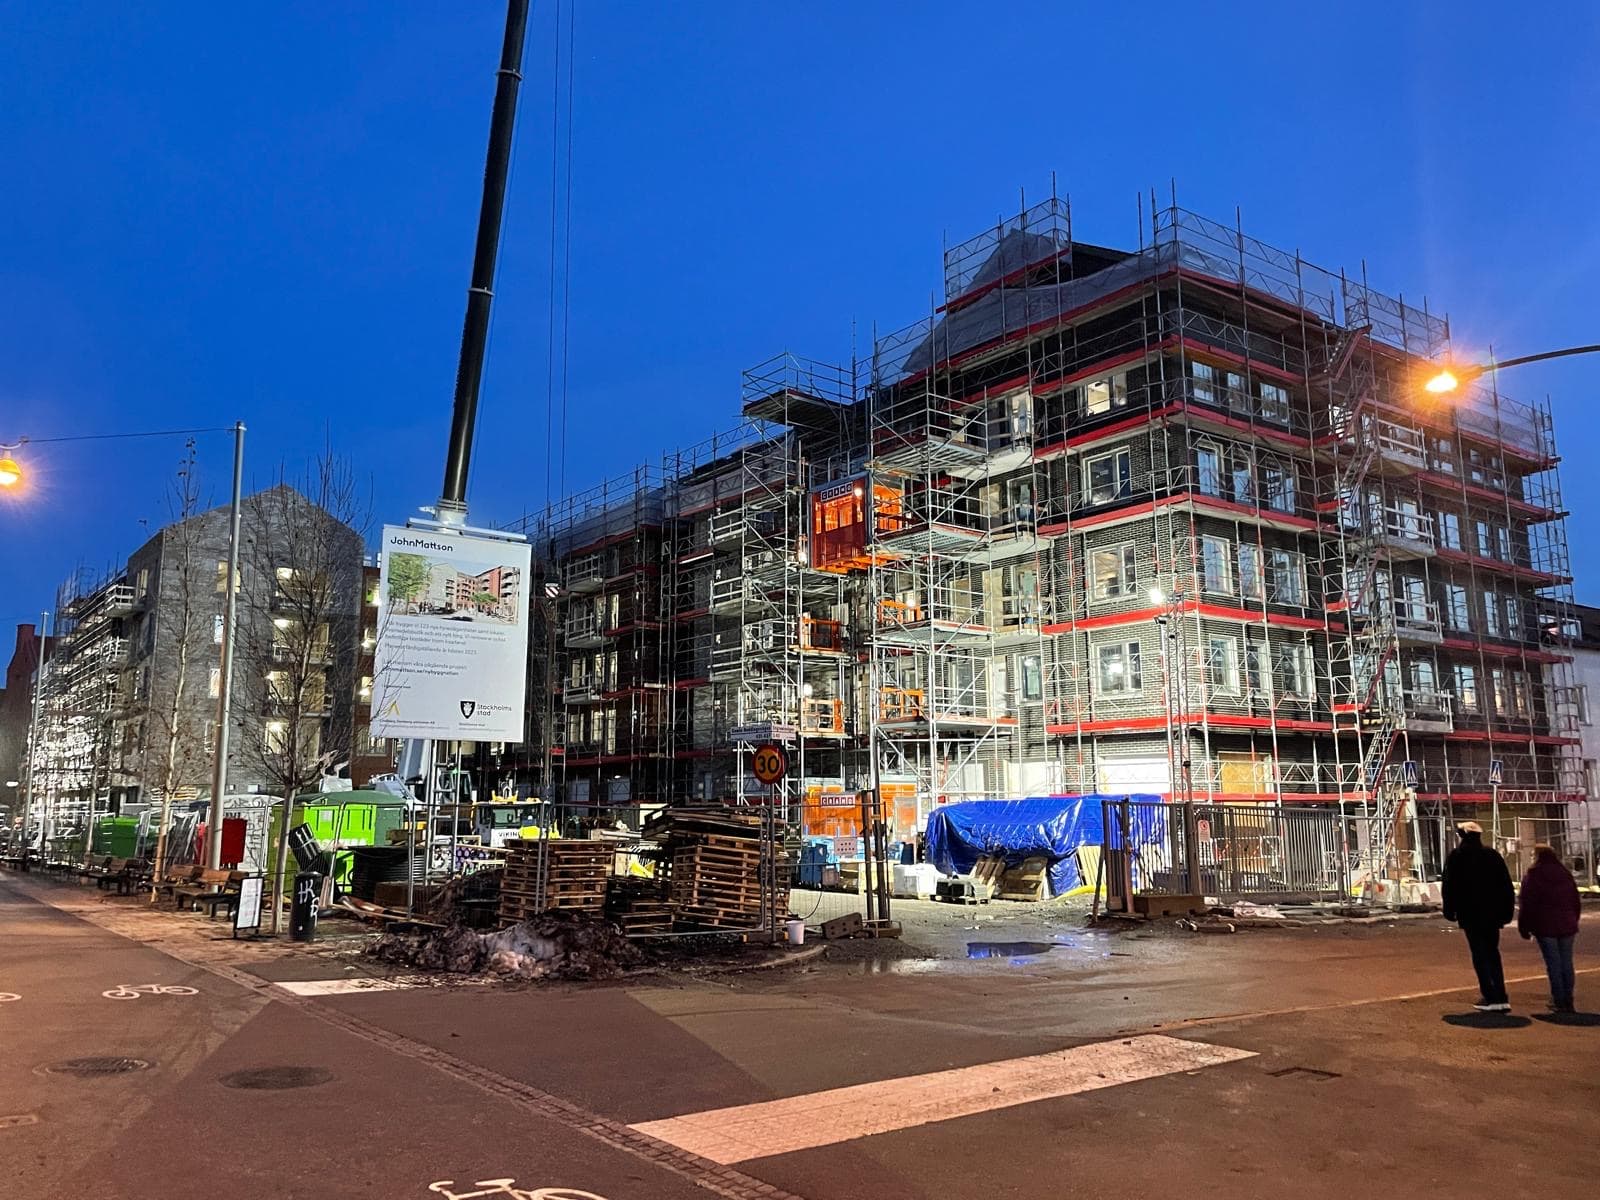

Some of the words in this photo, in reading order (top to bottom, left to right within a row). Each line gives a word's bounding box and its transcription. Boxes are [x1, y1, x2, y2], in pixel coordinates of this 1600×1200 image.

[390, 536, 454, 552] JohnMattson
[477, 703, 512, 712] Stockholms
[757, 755, 780, 774] 30
